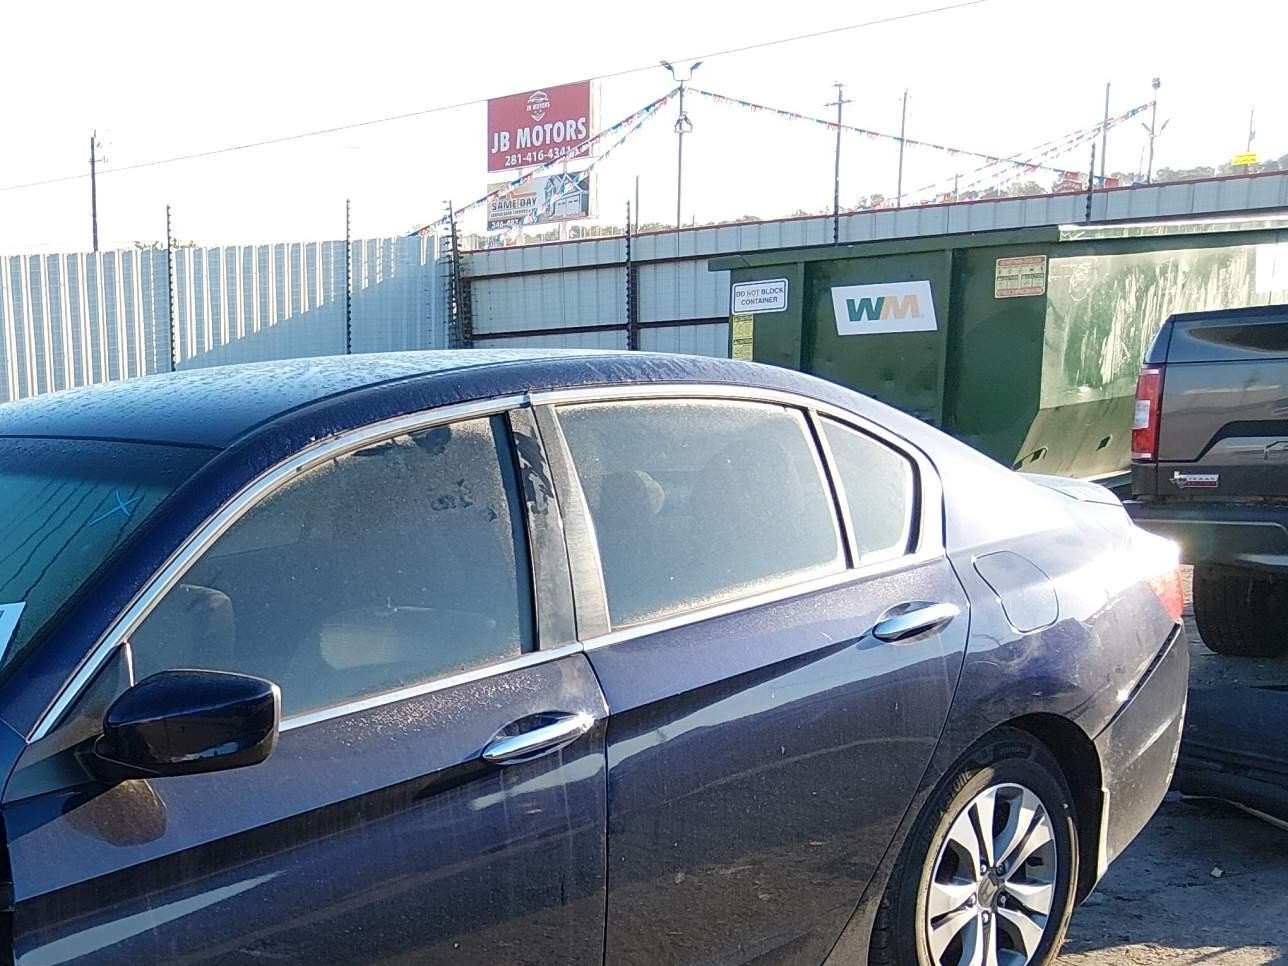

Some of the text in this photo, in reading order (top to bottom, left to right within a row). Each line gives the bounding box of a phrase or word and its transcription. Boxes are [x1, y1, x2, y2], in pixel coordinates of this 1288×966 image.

[491, 117, 587, 154] JB MOTORS
[491, 197, 538, 211] SAME DAY
[760, 287, 784, 295] BLOCK
[741, 296, 778, 306] CONTAINER
[846, 294, 921, 322] WM
